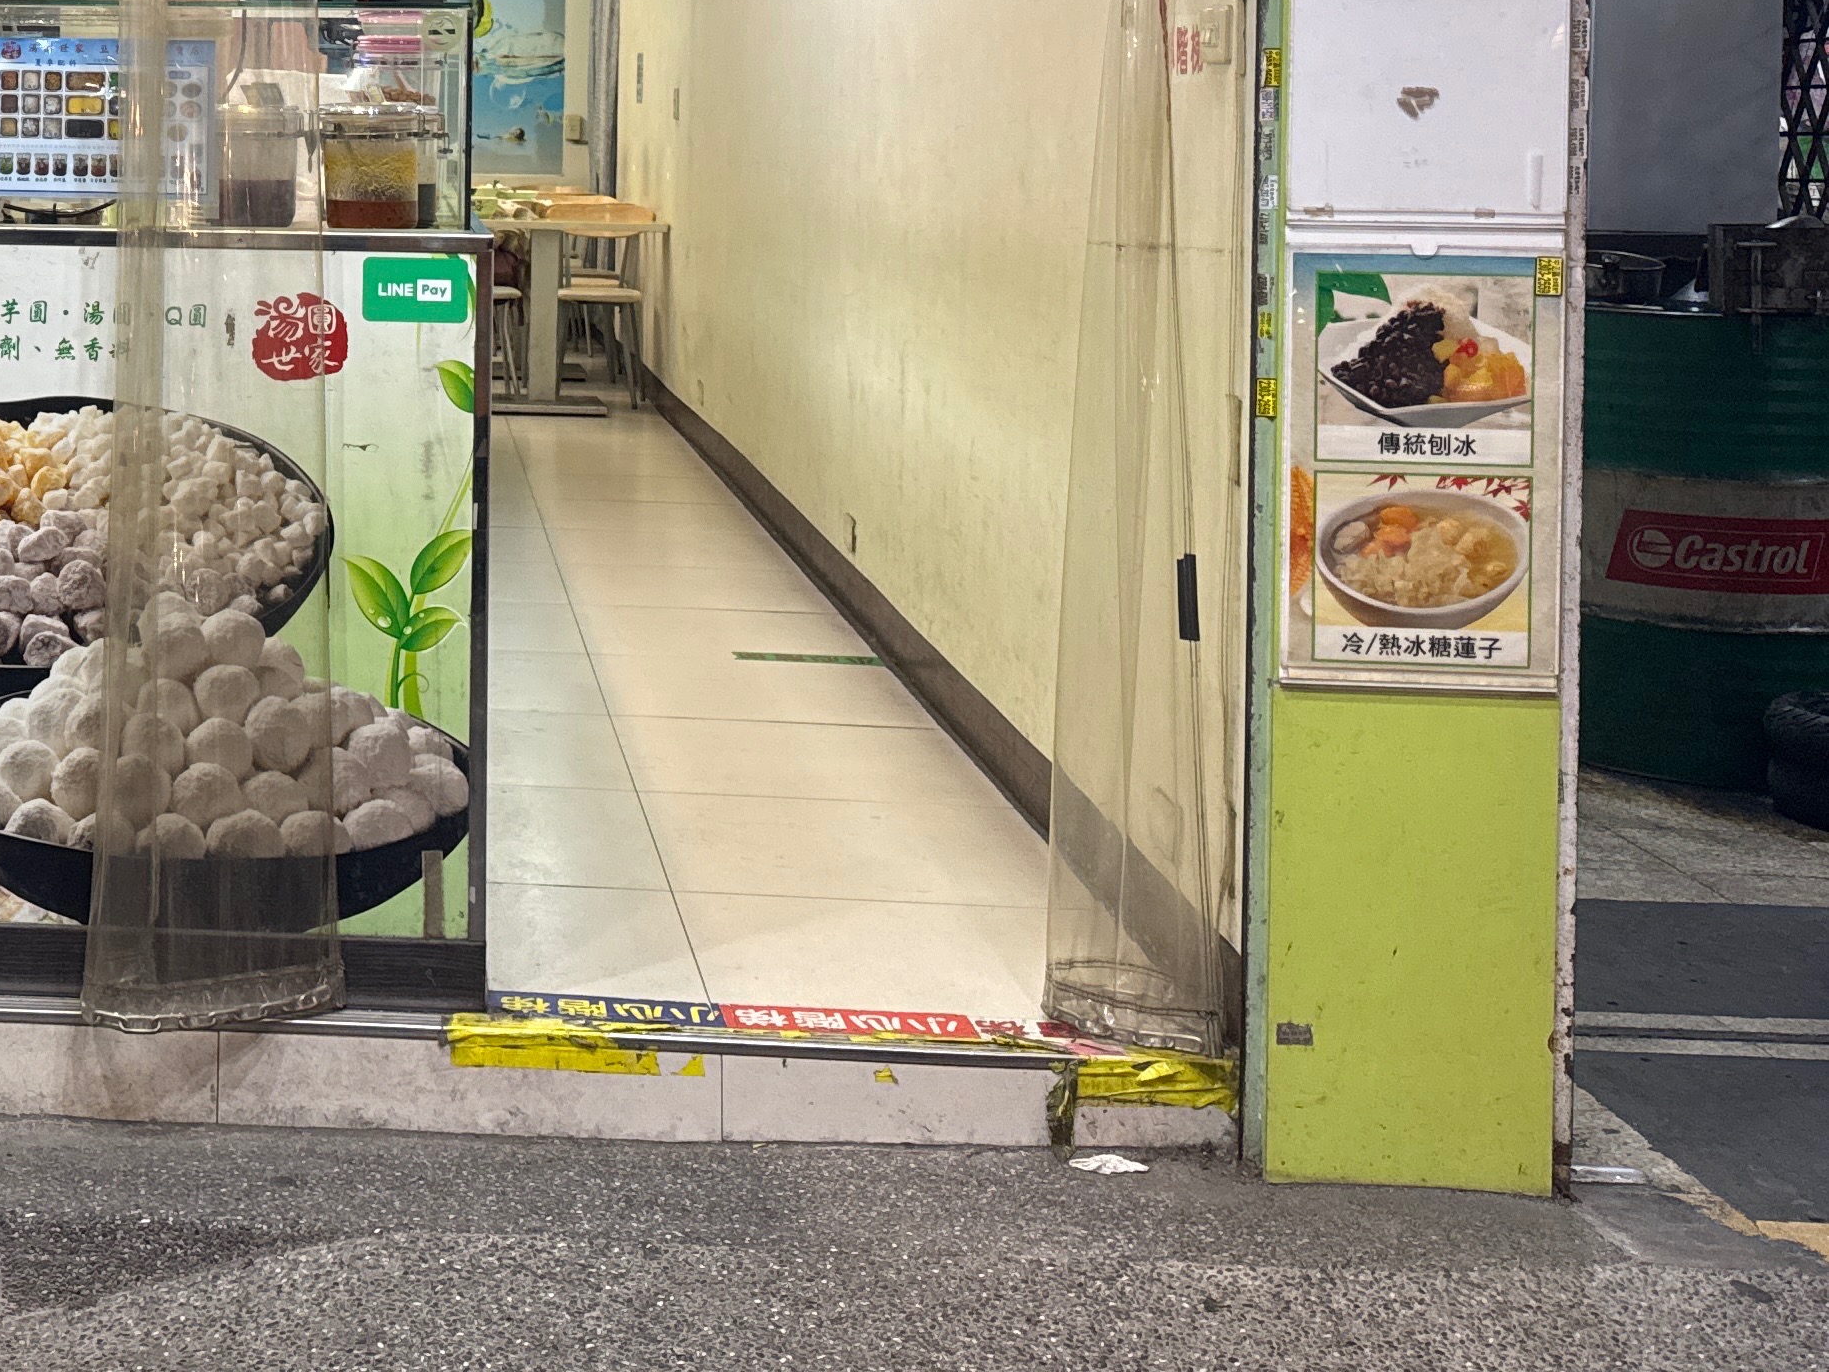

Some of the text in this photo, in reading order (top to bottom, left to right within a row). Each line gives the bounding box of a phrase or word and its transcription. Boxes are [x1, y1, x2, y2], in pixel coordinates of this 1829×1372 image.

[378, 283, 448, 299] LINE Pay
[1377, 431, 1477, 457] 傳統刨冰
[1673, 531, 1811, 575] Castrol
[1341, 632, 1502, 660] 冷/熱冰糖蓮子
[499, 994, 718, 1025] 小心階梯
[734, 1007, 958, 1034] 小心階梯
